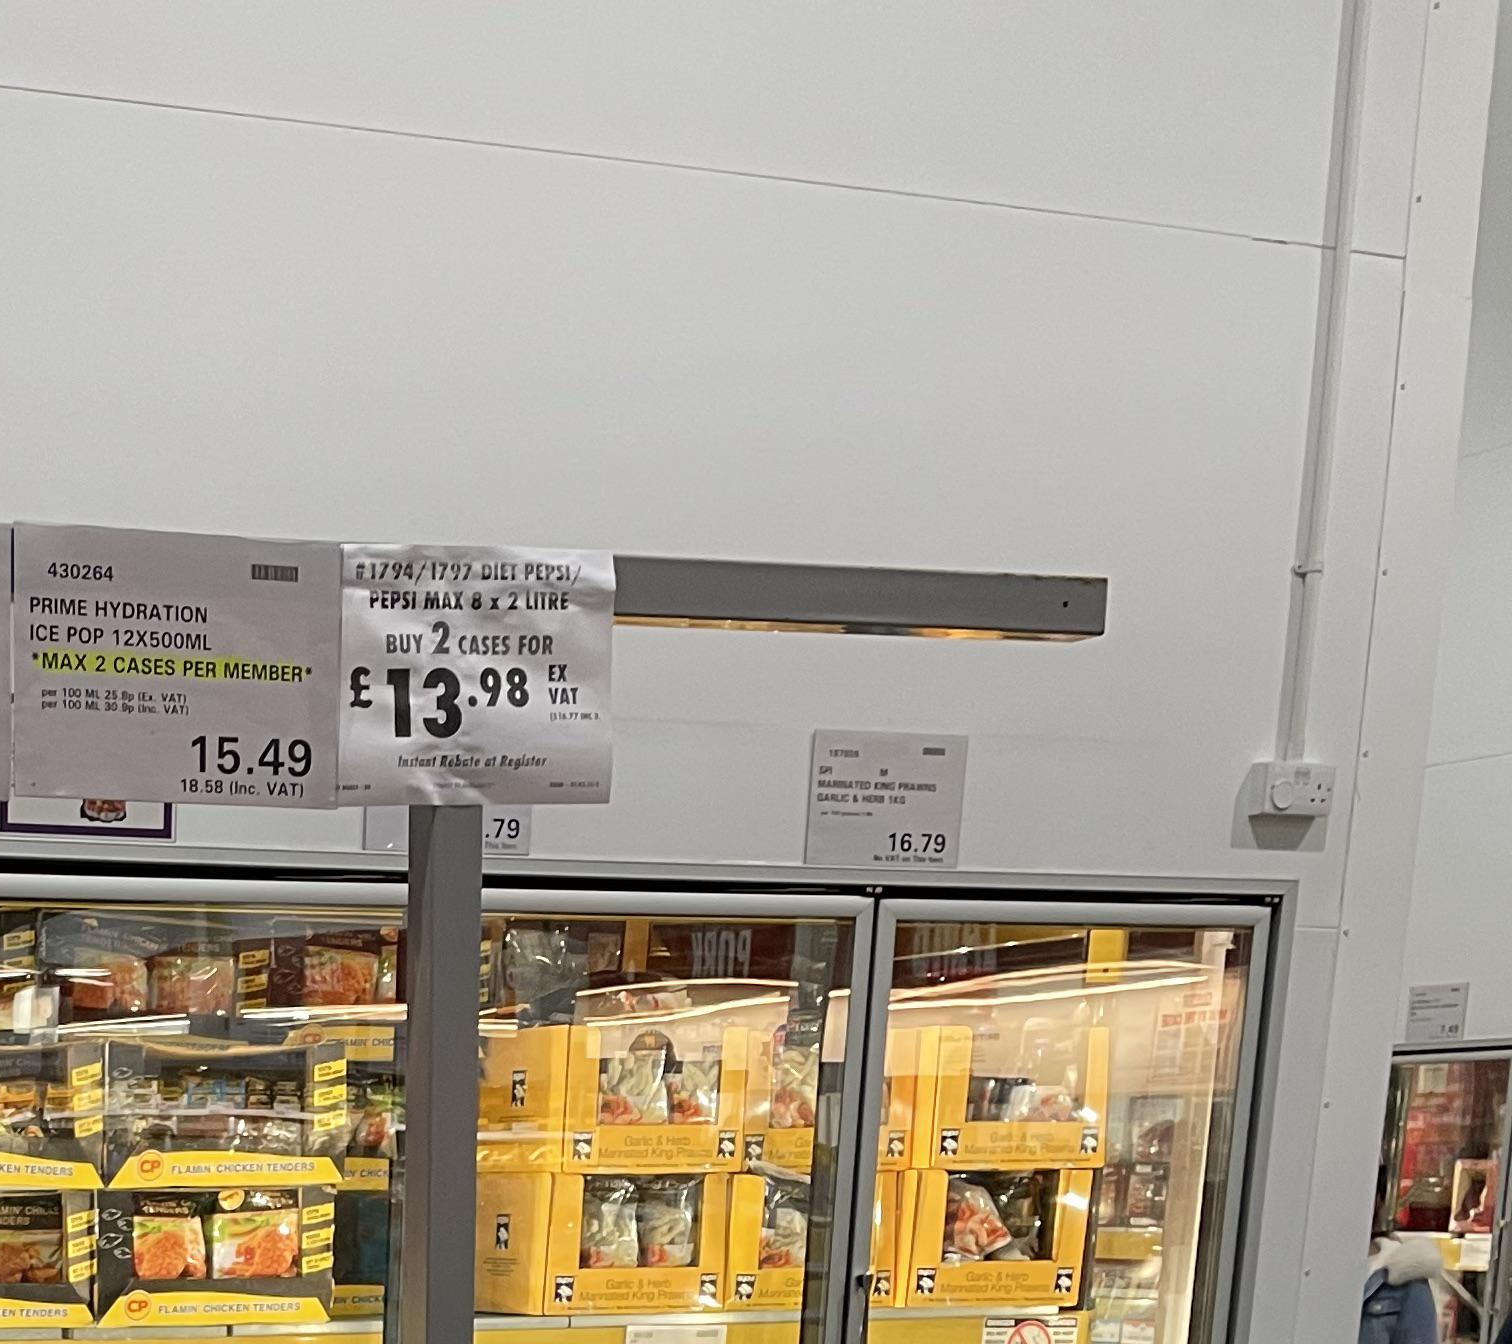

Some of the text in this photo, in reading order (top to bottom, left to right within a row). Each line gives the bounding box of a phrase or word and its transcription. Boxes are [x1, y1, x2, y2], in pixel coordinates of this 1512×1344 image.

[47, 562, 114, 581] 430264
[480, 561, 517, 581] DIET
[29, 596, 208, 624] PRIME HYDRATION
[369, 590, 570, 611] PEPSI MAX 8 x 2 LITRE
[29, 624, 212, 651] ICE POP 12X500ML
[386, 620, 554, 656] BUY 2 CASES FOR
[95, 655, 106, 673] 2
[113, 656, 176, 676] CASES
[183, 660, 217, 678] PER
[548, 664, 567, 682] EX
[62, 687, 82, 698] 100
[548, 687, 579, 705] VAT
[62, 699, 82, 710] 100
[191, 735, 312, 778] 15.49
[398, 754, 548, 771] Instant Rebate at Register
[180, 778, 304, 798] 18.58 (Inc. VAT)
[888, 832, 946, 853] 16.79
[24, 1165, 74, 1176] TENDERS
[140, 1159, 161, 1173] CP
[215, 1162, 263, 1174] CHICKEN
[266, 1160, 315, 1172] TENDERS
[127, 1298, 300, 1313] CP TENDERS
